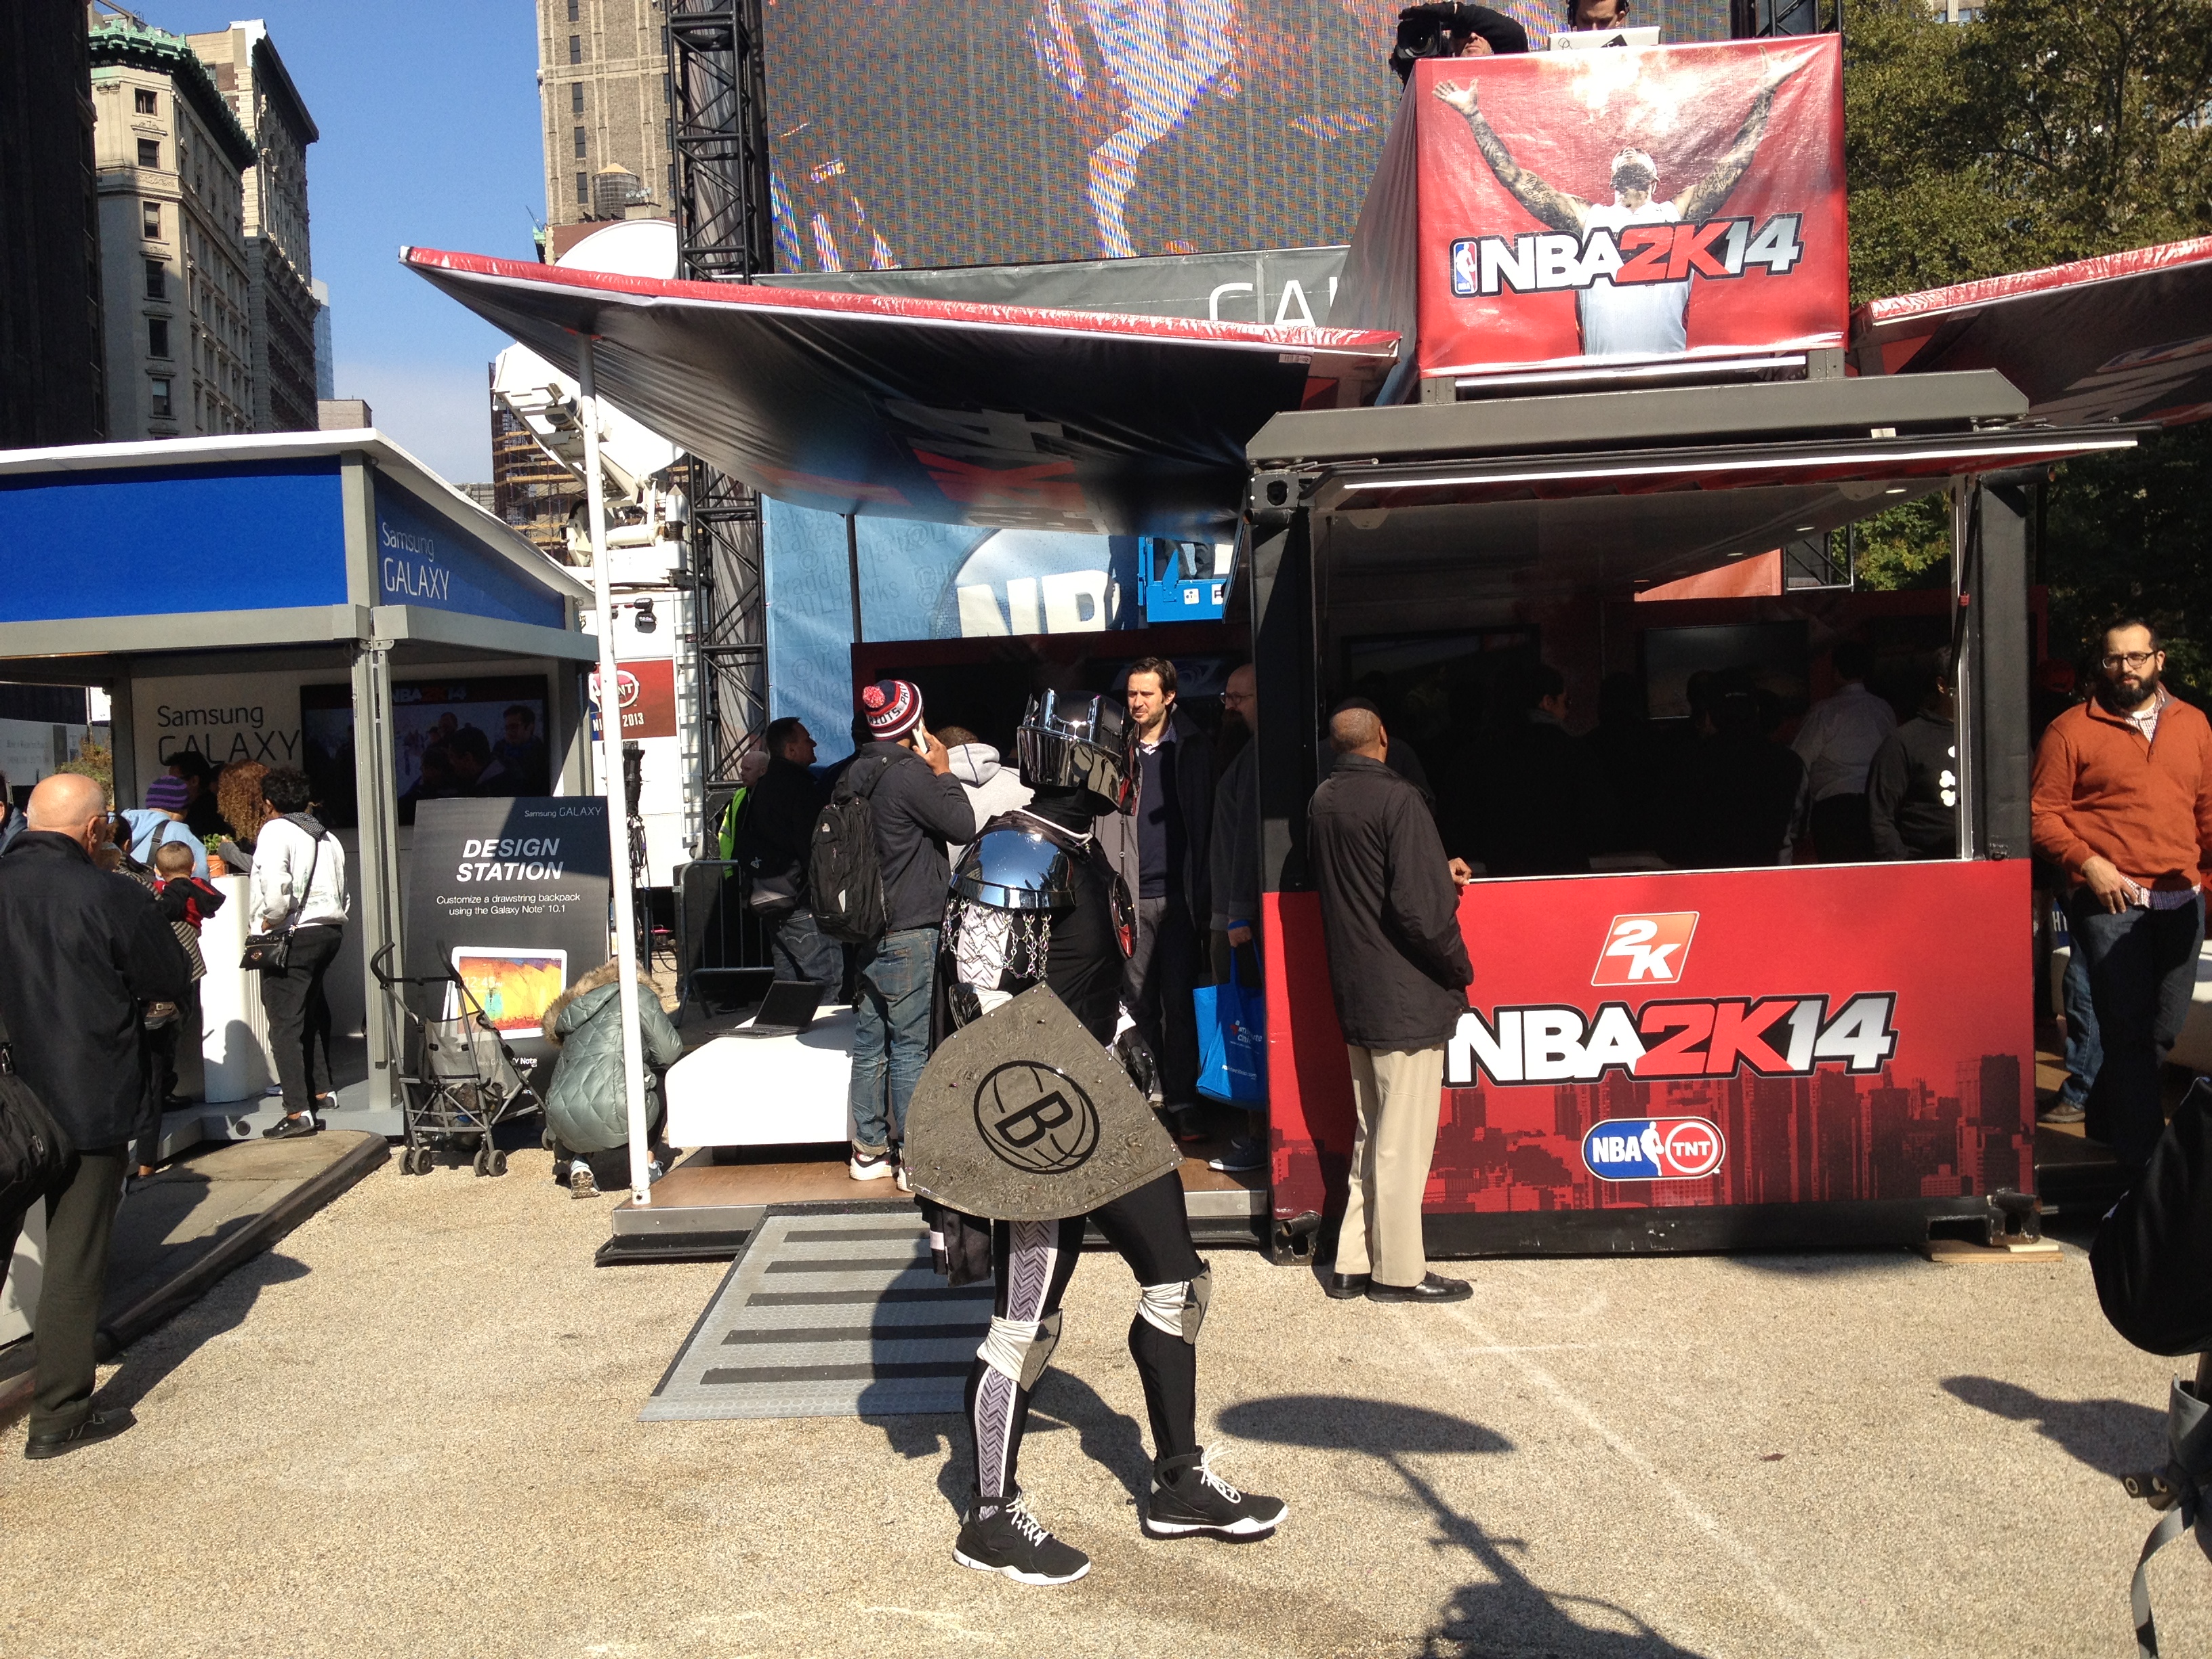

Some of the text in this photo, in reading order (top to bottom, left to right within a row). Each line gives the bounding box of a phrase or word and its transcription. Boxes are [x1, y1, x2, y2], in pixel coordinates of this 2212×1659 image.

[1481, 218, 1801, 293] NBA2K14
[382, 521, 434, 562] Samsung
[384, 557, 449, 600] GALAXY
[157, 705, 264, 729] Samsung
[621, 712, 644, 728] 2013
[525, 806, 602, 819] Samsung GALAXY
[463, 838, 560, 858] DESIGN
[456, 861, 564, 882] STATION
[436, 895, 482, 905] Customize
[492, 893, 536, 906] drawstring
[539, 893, 581, 903] backpack
[449, 906, 472, 917] using
[474, 905, 488, 915] the
[491, 905, 520, 916] Galaxy
[548, 904, 566, 913] 10.1
[1606, 920, 1681, 980] 2K
[1448, 998, 1893, 1083] NBA2K14
[994, 1090, 1073, 1149] B
[1592, 1136, 1711, 1163] NBA TNT
